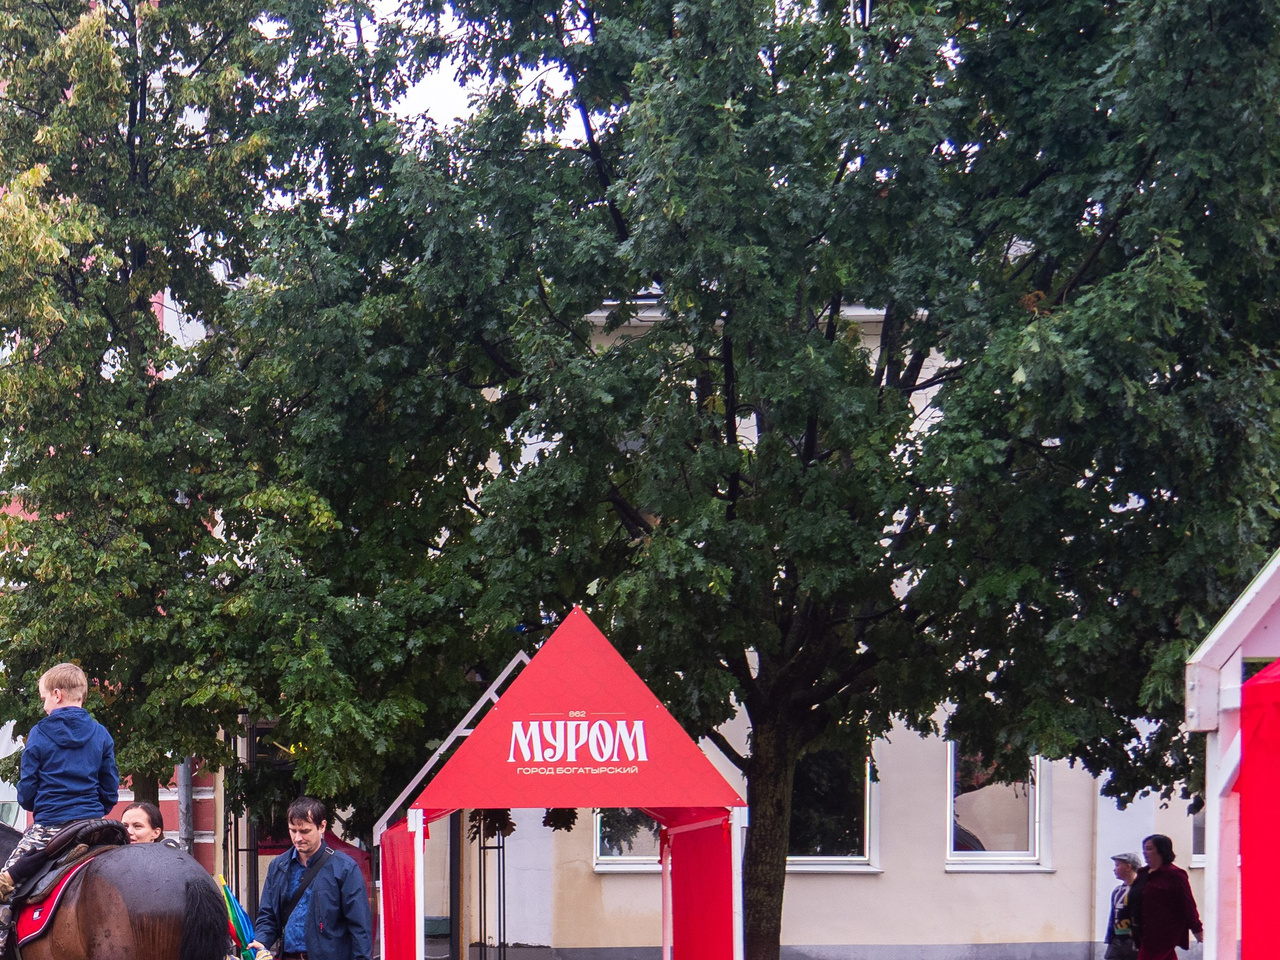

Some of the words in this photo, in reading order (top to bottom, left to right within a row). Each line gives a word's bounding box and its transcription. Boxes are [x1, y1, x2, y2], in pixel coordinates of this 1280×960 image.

[507, 720, 649, 763] МУРОМ
[517, 767, 555, 775] ГОРОД
[556, 766, 639, 775] БОГАТЫРСКИЙ
